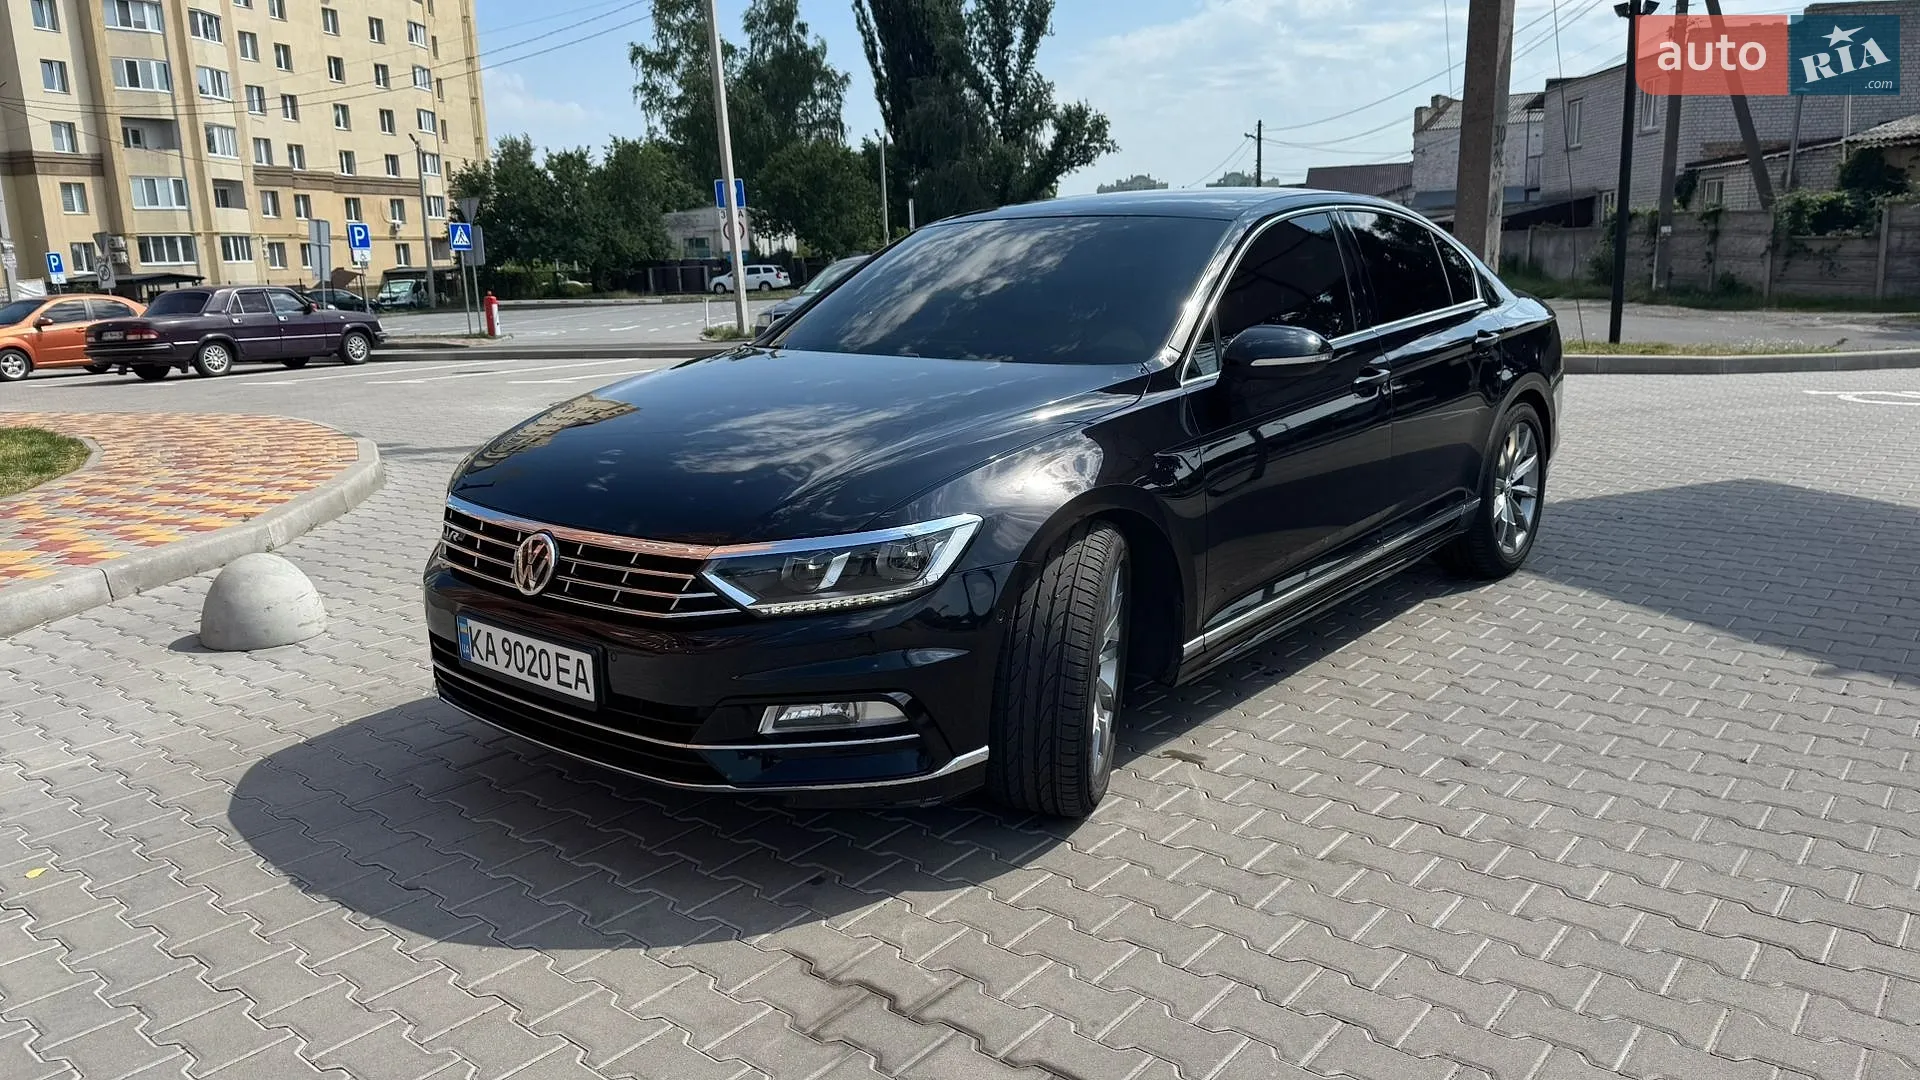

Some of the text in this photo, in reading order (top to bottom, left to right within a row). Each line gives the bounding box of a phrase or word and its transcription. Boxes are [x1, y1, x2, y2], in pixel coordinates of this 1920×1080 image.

[720, 210, 744, 219] ЗА
[353, 226, 366, 246] P
[50, 255, 59, 272] P
[469, 626, 590, 694] KA 9020 EA
